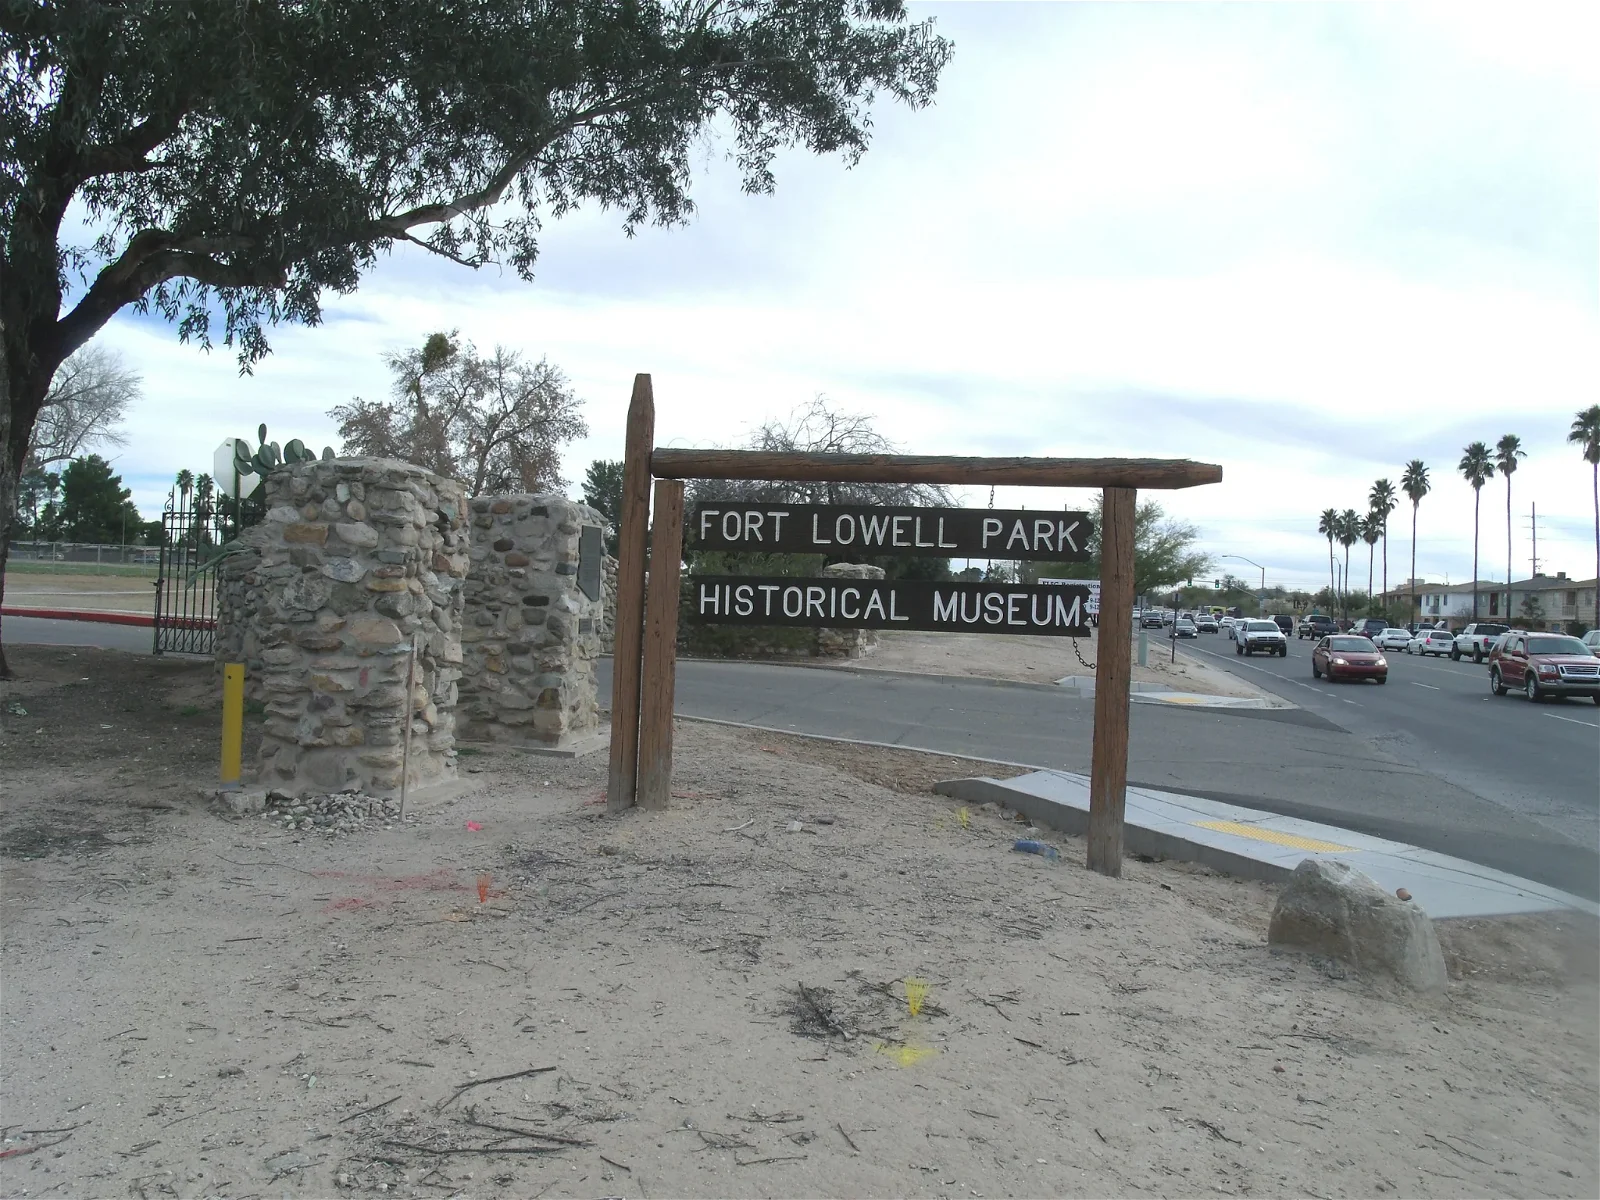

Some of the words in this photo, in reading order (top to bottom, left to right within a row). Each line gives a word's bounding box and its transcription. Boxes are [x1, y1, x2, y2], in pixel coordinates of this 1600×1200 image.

[700, 510, 790, 543] FORT
[812, 513, 958, 549] LOWELL
[982, 517, 1081, 554] PARK
[700, 583, 910, 622] HISTORICAL
[932, 590, 1081, 627] MUSEUM
